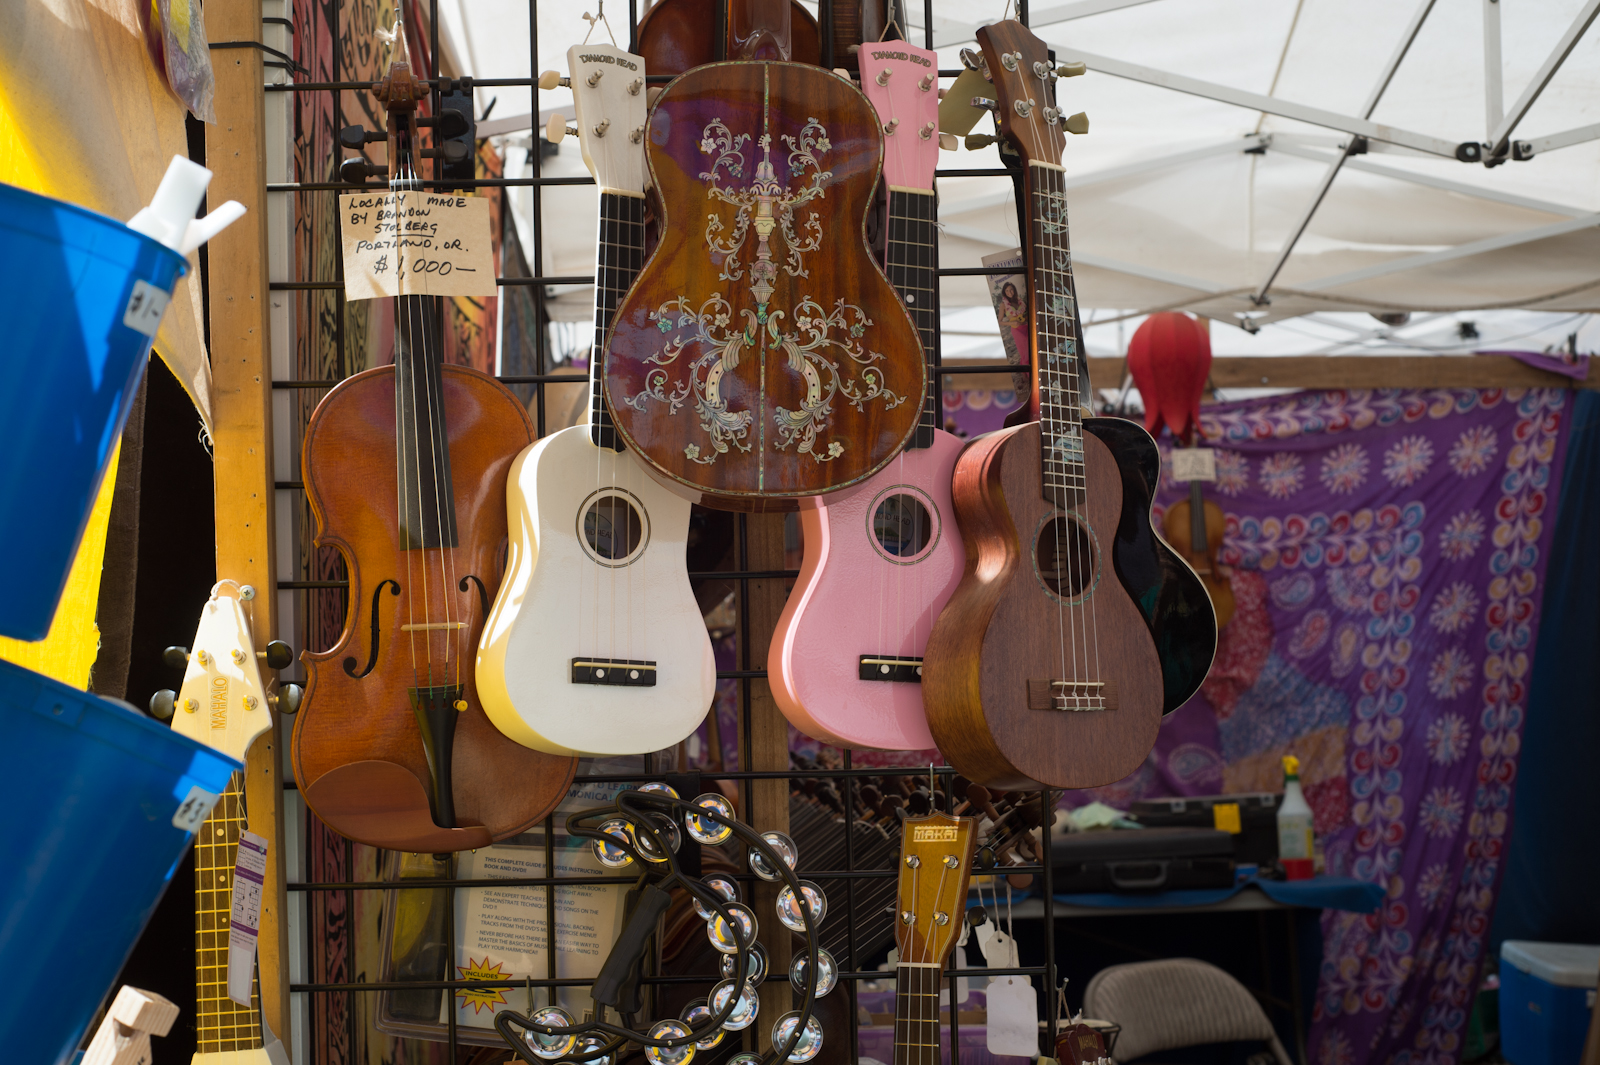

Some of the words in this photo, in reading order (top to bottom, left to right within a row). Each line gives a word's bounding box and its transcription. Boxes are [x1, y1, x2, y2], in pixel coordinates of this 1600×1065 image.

[579, 54, 615, 64] DIAMOND
[617, 58, 637, 71] HEAD
[871, 51, 908, 61] DIAMOND
[910, 54, 931, 67] HEAD
[349, 195, 406, 209] LOCALLY
[427, 197, 466, 207] MADE
[351, 212, 367, 224] BY
[376, 207, 430, 220] BRANDON
[375, 220, 438, 234] STOLBERG
[356, 239, 438, 253] PORTLAND,
[444, 239, 468, 251] OR.
[875, 513, 892, 521] MOND
[210, 676, 228, 730] MAHALO
[567, 790, 612, 801] MONICA!
[569, 867, 603, 875] INSTRUCTION
[483, 897, 519, 905] DEMONSTRATE
[466, 971, 498, 979] INCLUDES
